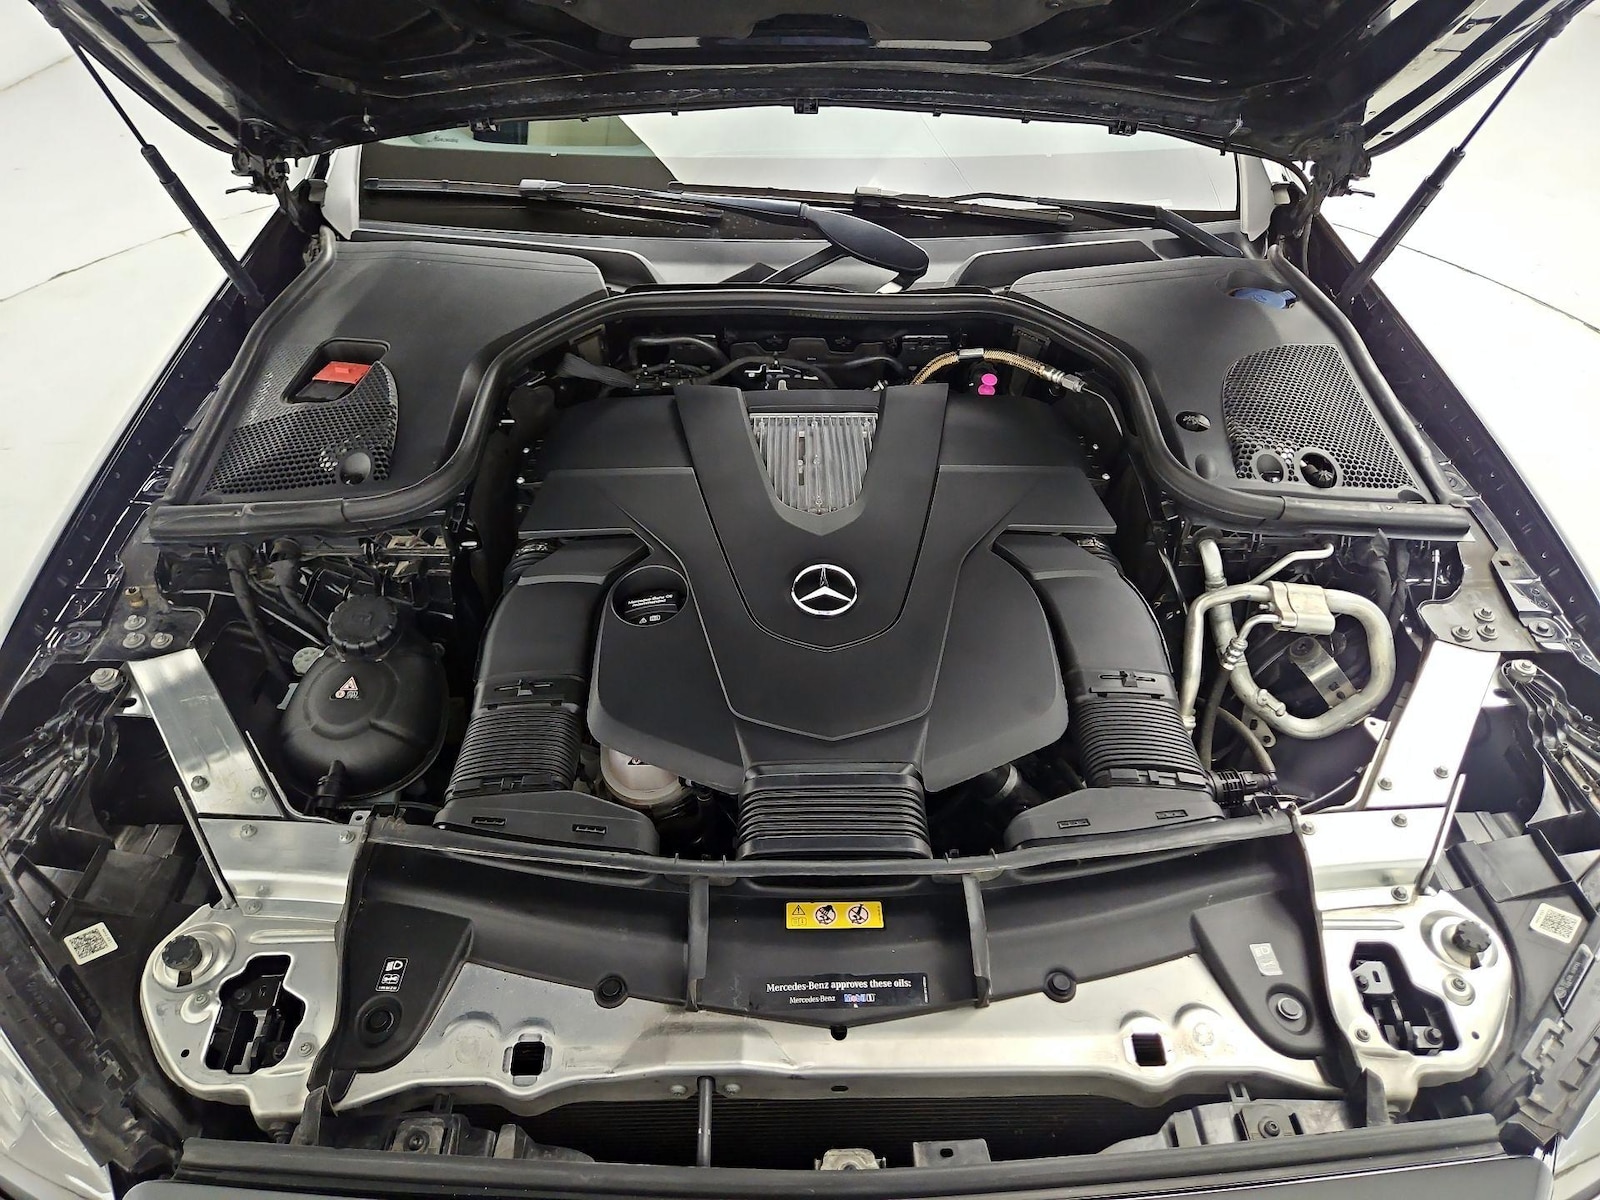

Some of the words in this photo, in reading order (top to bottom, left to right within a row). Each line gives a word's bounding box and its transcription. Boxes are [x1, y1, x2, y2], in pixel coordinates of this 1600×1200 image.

[766, 980, 829, 992] Mercedes-Benz
[831, 979, 868, 991] approves
[869, 979, 892, 988] these
[789, 994, 836, 1004] Mercedes-Benz
